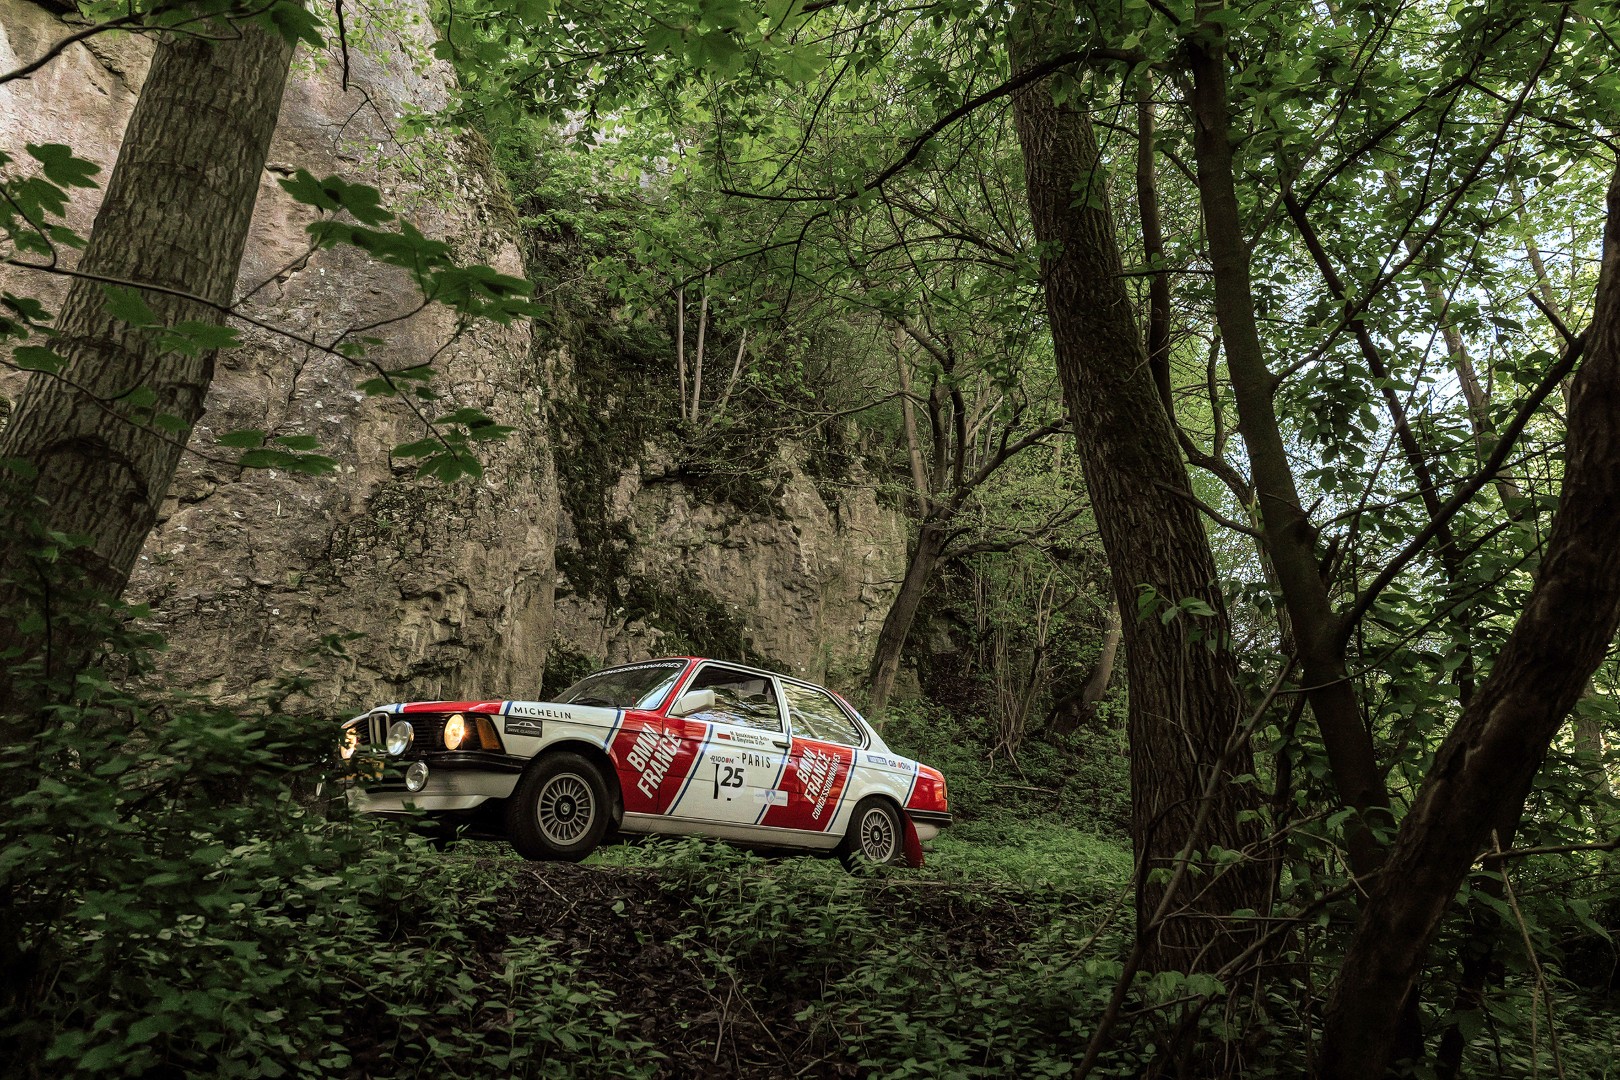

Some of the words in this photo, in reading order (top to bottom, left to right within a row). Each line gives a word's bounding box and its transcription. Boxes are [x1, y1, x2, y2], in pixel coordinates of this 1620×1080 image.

[514, 707, 572, 720] MICHELIN
[626, 722, 660, 773] BMW
[637, 727, 683, 799] FRANCE
[796, 746, 817, 785] BMW
[804, 749, 831, 805] FRANCE
